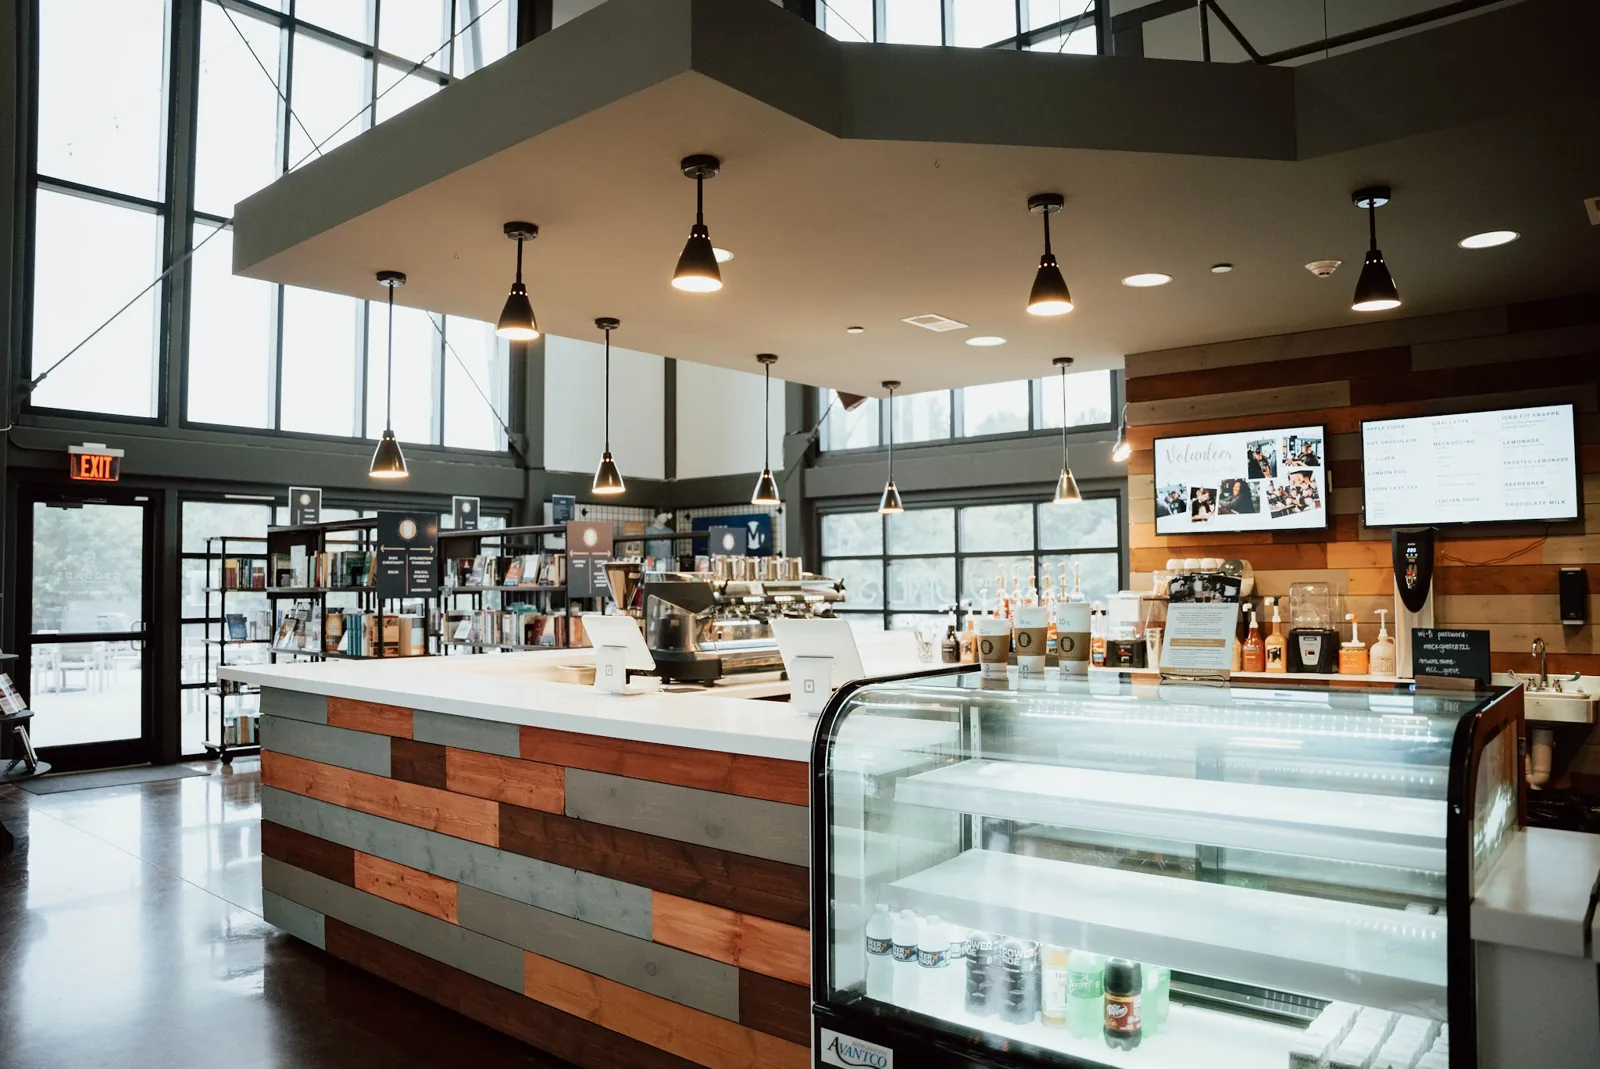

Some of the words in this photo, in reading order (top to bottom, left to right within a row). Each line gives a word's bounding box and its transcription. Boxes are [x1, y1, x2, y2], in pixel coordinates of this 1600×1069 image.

[1166, 442, 1232, 463] Volunteer
[81, 455, 112, 478] EXIT
[1002, 947, 1034, 959] POWER
[827, 1036, 887, 1068] AVANTCO
[1290, 1053, 1317, 1064] Honest
